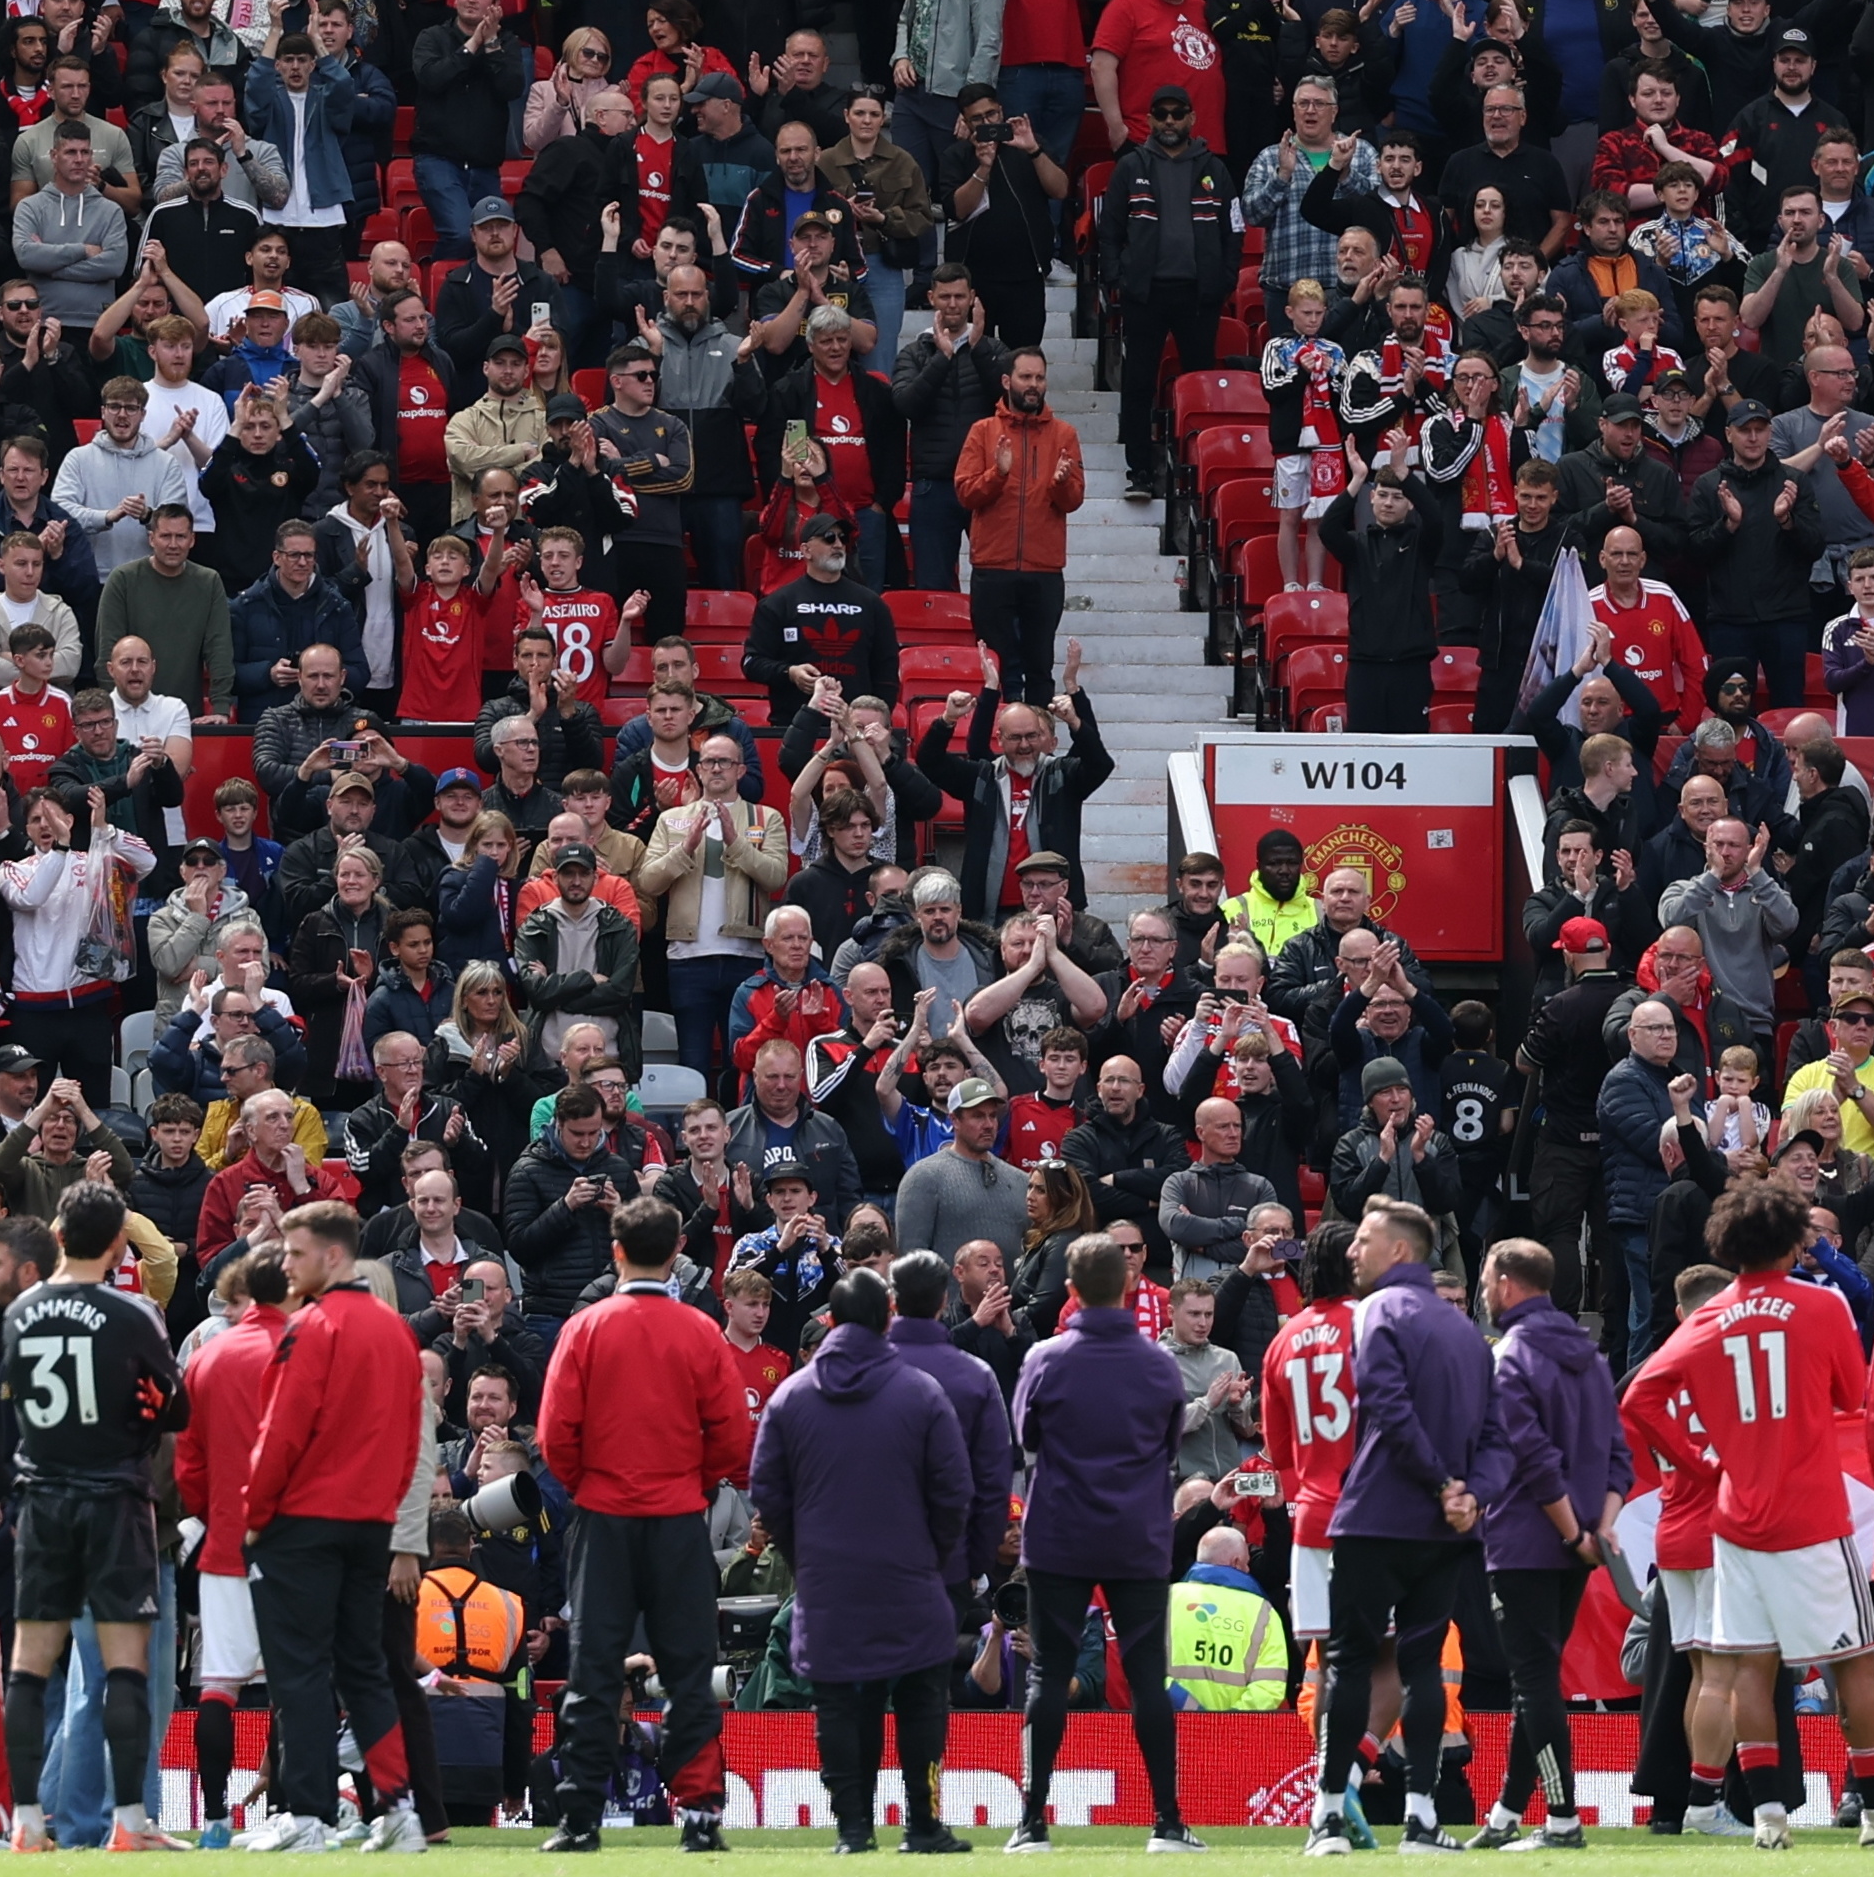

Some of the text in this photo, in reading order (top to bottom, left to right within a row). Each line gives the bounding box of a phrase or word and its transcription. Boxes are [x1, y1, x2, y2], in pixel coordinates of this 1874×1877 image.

[1424, 325, 1444, 338] NITED
[396, 407, 448, 421] napdragon
[541, 602, 601, 620] ASEMIRO
[797, 602, 862, 615] SHARP
[786, 629, 795, 640] 92
[551, 620, 593, 683] 18
[8, 752, 56, 764] napdragon
[1301, 761, 1406, 791] W104
[1309, 826, 1396, 873] MANCHESTER
[1453, 1098, 1484, 1142] 8
[16, 1282, 105, 1331] LAMMENS
[1715, 1300, 1794, 1331] ZIRKZEE
[1292, 1318, 1339, 1348] DORGU
[20, 1333, 99, 1430] 31
[1722, 1329, 1786, 1424] 11
[1285, 1351, 1344, 1446] 13
[430, 1598, 489, 1611] RESNSE
[1212, 1617, 1246, 1634] CSG
[1193, 1639, 1234, 1666] 510
